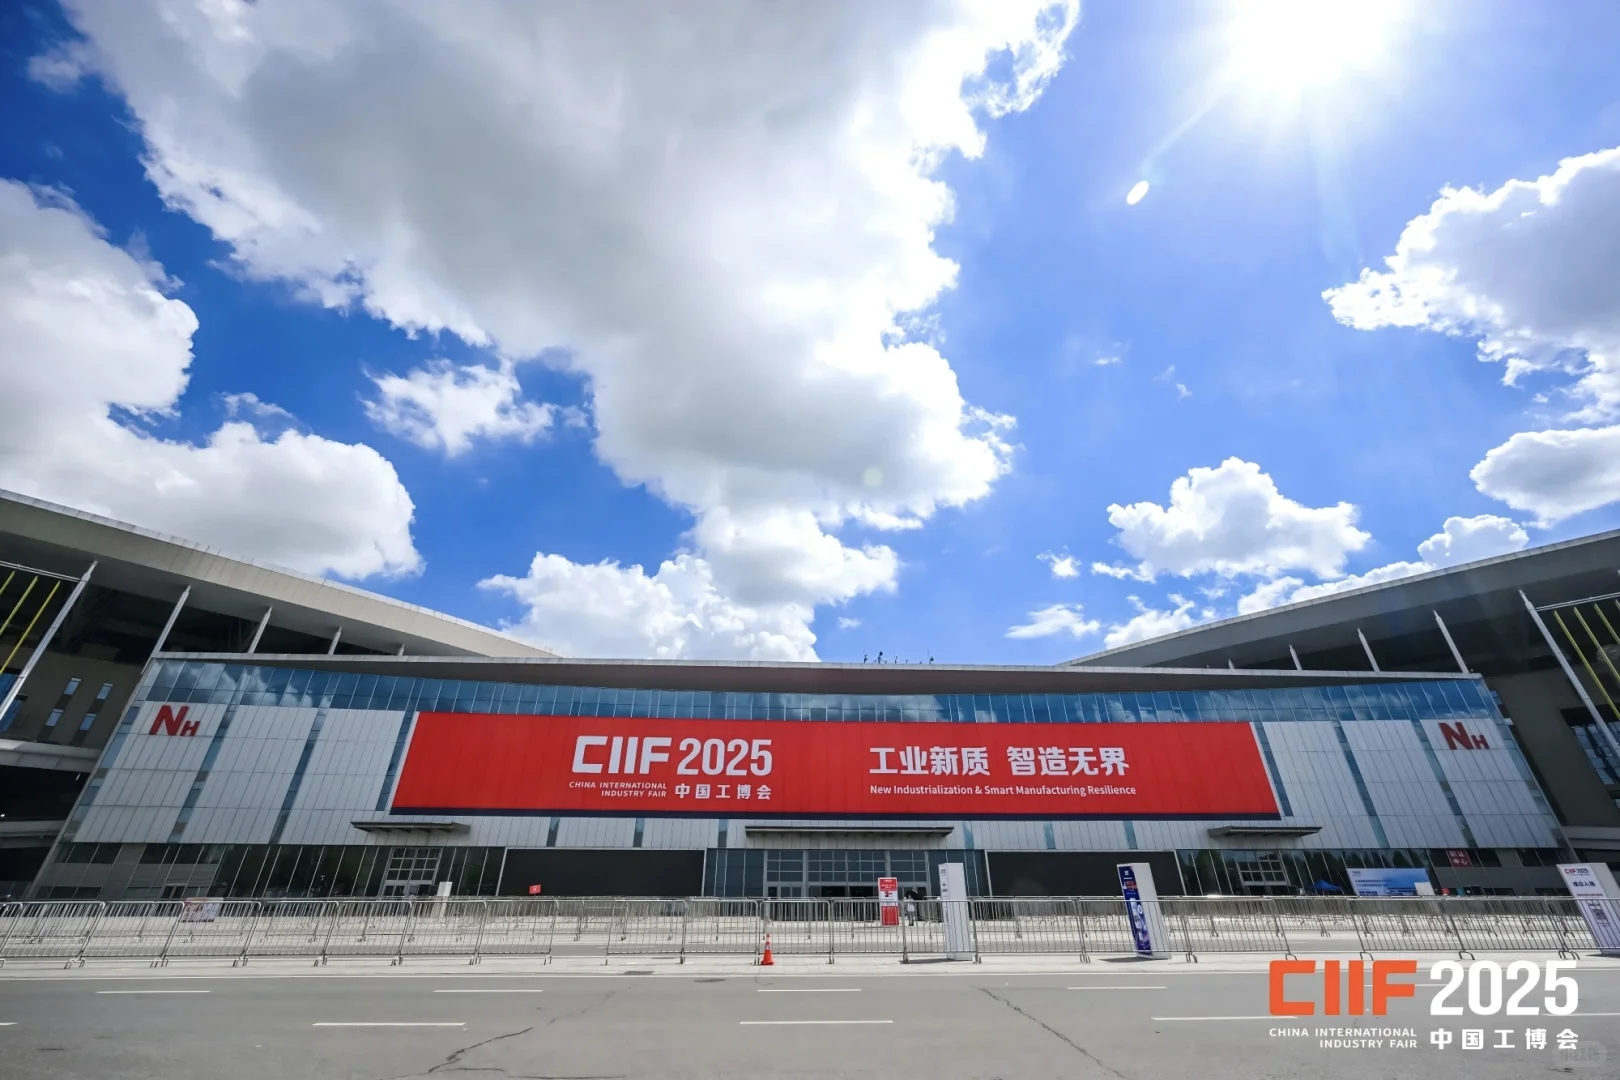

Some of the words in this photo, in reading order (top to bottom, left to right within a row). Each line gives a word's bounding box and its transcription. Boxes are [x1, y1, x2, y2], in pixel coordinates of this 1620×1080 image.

[572, 735, 672, 774] CIIF
[677, 738, 773, 776] 2025
[869, 746, 991, 776] 工业新质
[1007, 746, 1130, 776] 智造无界
[599, 782, 668, 790] INTERNATIONAL
[601, 789, 644, 797] INDUSTRY
[675, 783, 771, 800] 中国工博会
[870, 785, 892, 795] New
[893, 784, 973, 795] Industrialization
[975, 785, 983, 795] &
[984, 785, 1014, 796] Smart
[1016, 785, 1086, 797] Manufacturing
[1087, 785, 1136, 796] Resilience
